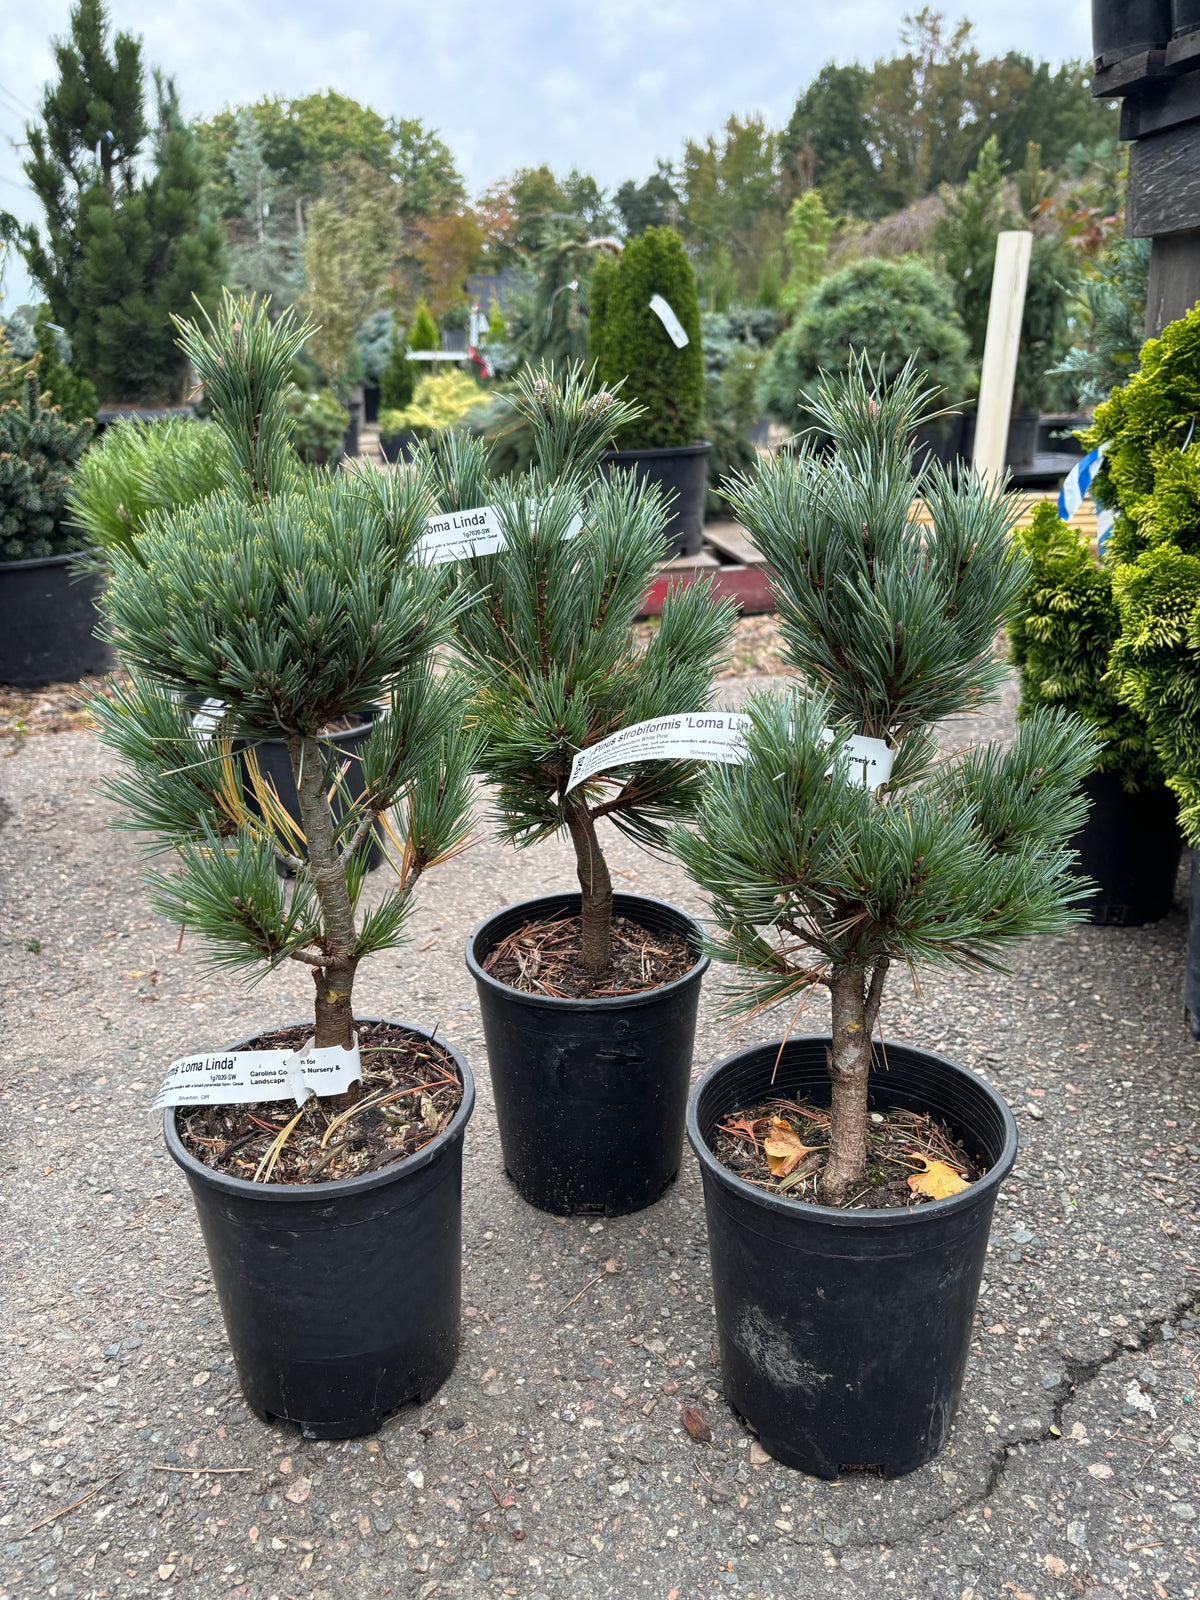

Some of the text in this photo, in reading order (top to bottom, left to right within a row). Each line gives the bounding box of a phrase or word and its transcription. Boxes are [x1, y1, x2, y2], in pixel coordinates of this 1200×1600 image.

[426, 512, 487, 534] oma Linda'
[618, 718, 681, 742] strobiformis
[686, 717, 723, 729] 'Loma
[205, 1057, 236, 1070] Linda'
